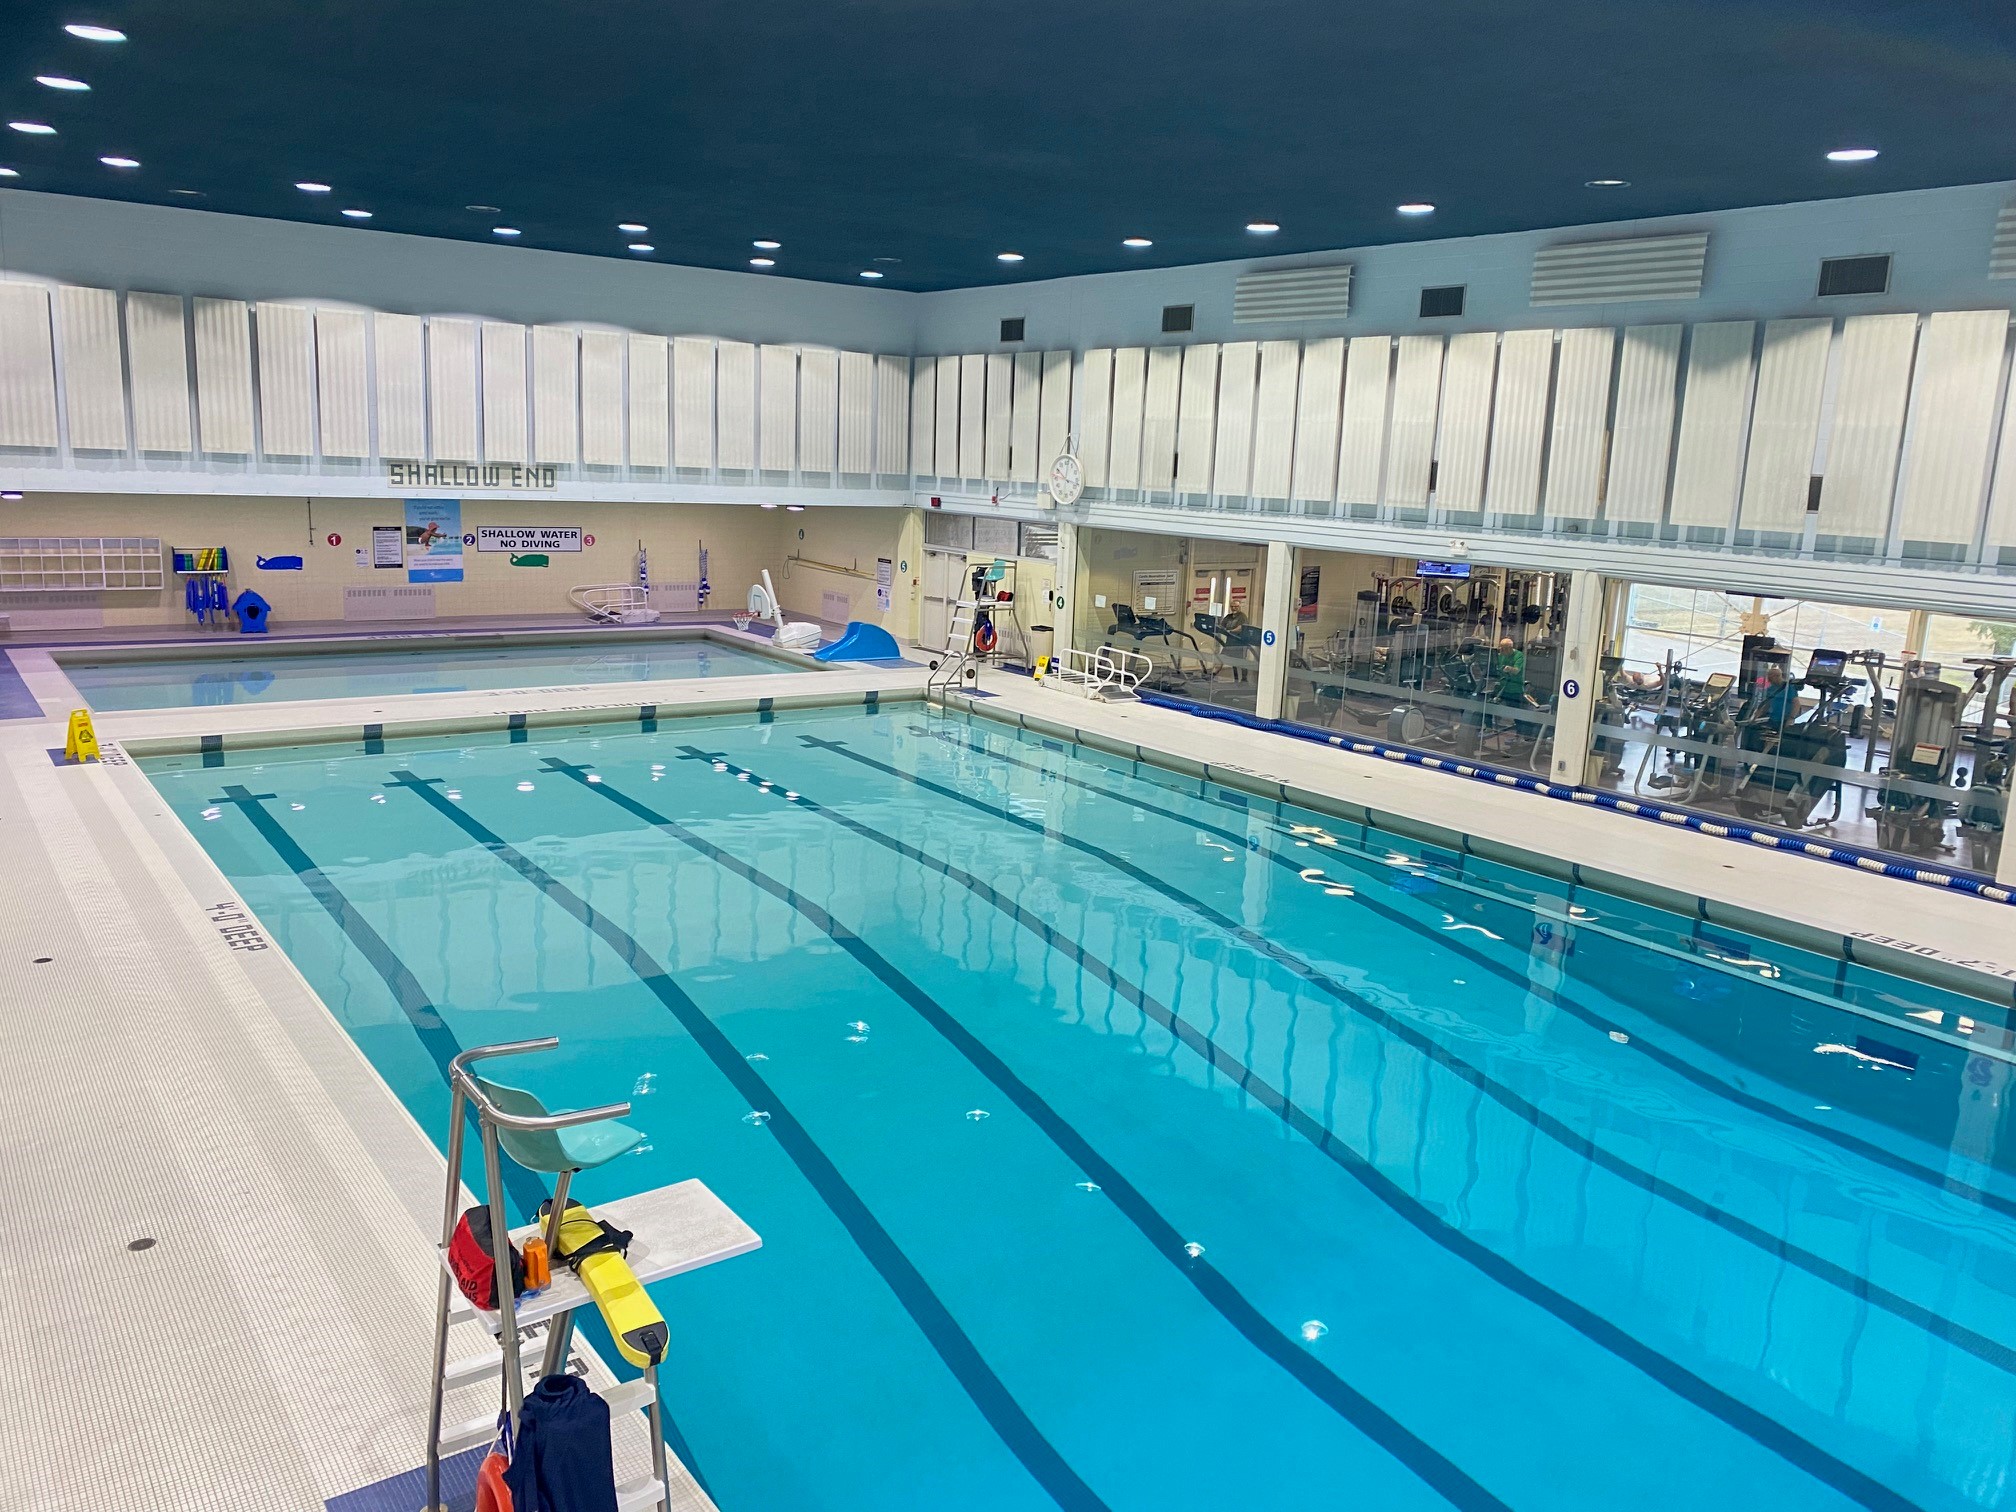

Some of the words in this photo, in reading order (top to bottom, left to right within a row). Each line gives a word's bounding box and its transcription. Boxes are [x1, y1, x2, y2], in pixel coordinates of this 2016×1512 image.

[390, 464, 500, 487] SHALLOW
[511, 466, 555, 488] END
[481, 530, 535, 539] SHALLOW
[540, 530, 578, 539] WATER
[465, 536, 473, 546] 2
[500, 540, 517, 548] NO
[521, 540, 560, 548] DIVING
[586, 537, 593, 546] 3
[1266, 632, 1273, 643] 5
[1567, 682, 1576, 695] 6
[219, 924, 269, 952] DEEP
[1850, 931, 1940, 956] DEEP
[460, 1277, 478, 1291] AID
